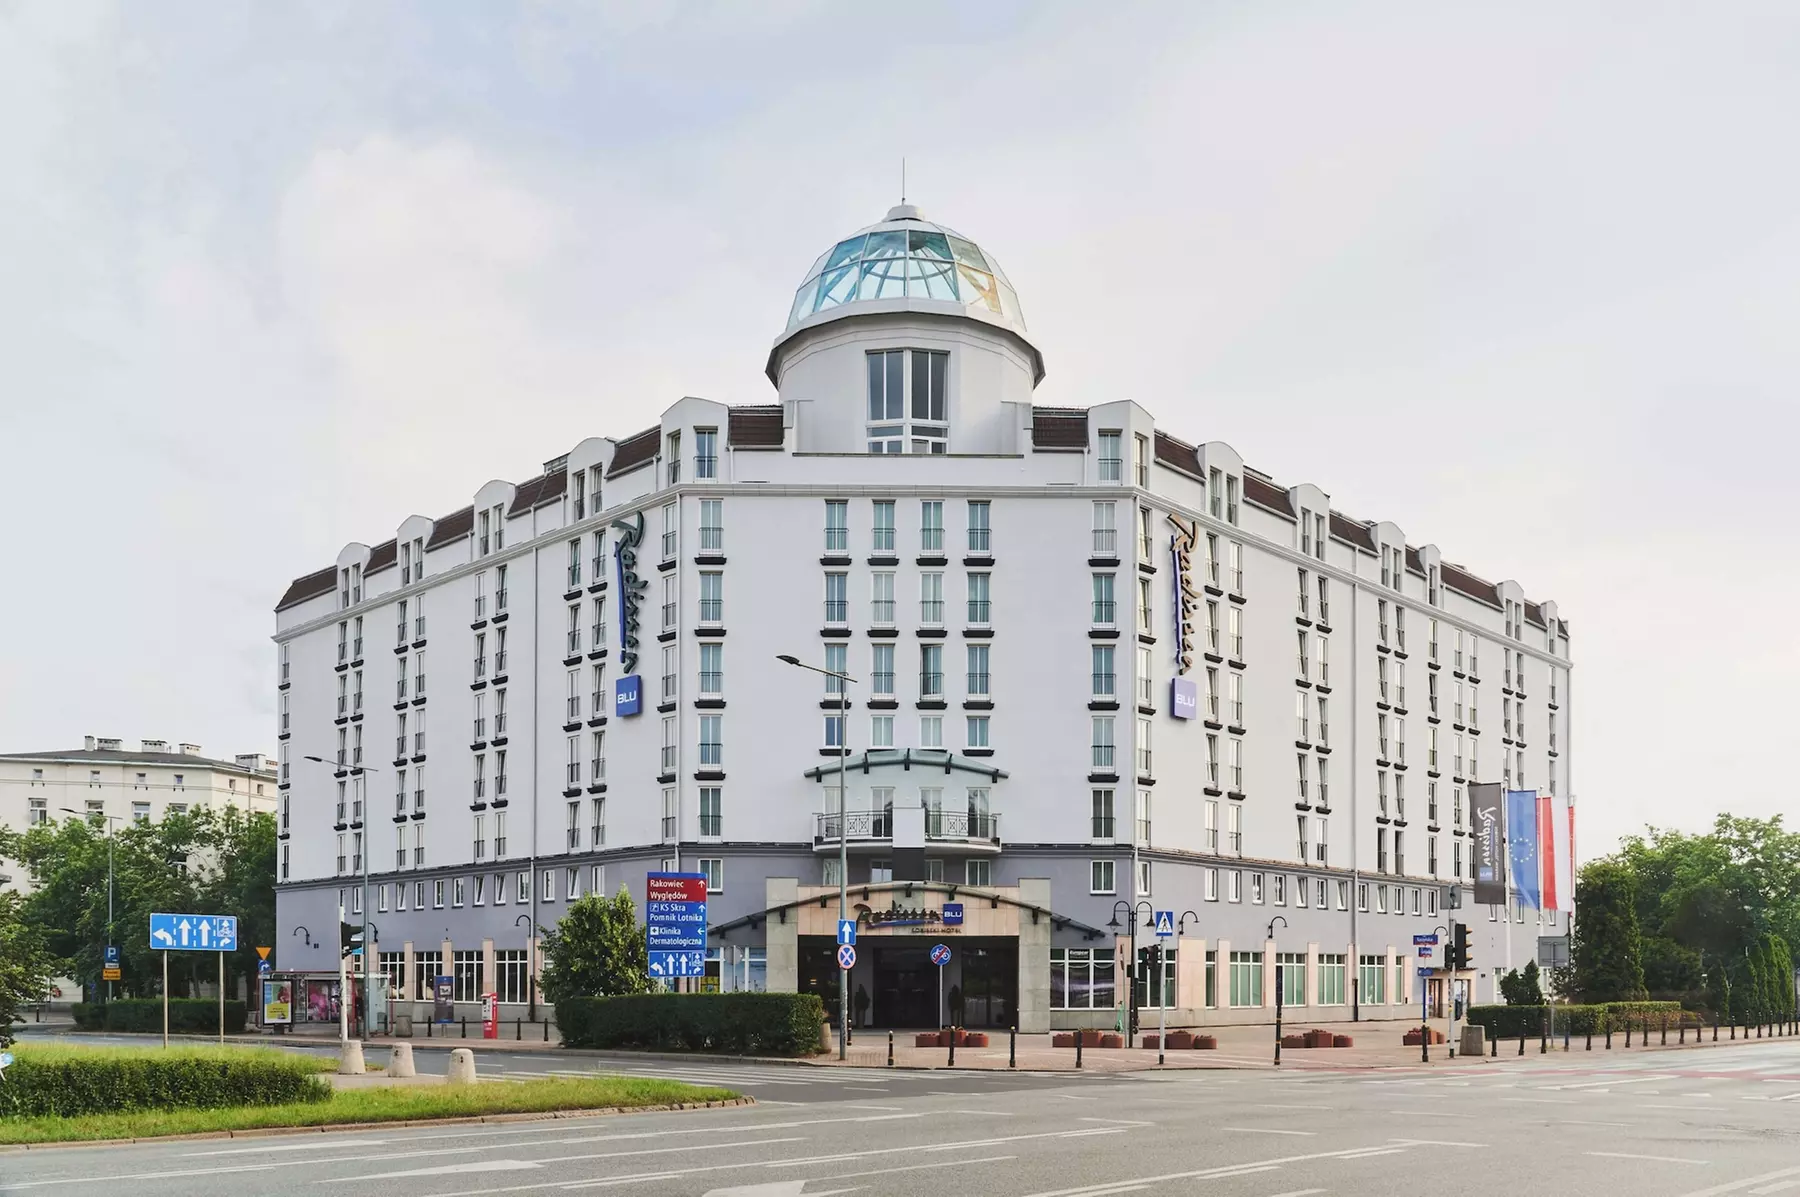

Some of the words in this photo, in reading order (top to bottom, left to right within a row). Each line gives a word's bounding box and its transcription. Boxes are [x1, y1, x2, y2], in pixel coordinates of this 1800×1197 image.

[611, 510, 649, 674] Radisson
[1167, 512, 1203, 676] Radisson
[617, 691, 638, 704] BLU
[1175, 692, 1195, 707] BLU
[650, 879, 684, 888] Rakowiec
[650, 891, 688, 901] Wyględów
[660, 904, 669, 912] KS
[670, 904, 686, 912] Skra
[650, 914, 676, 922] Pomnik
[678, 914, 703, 922] Lotnika
[660, 927, 681, 935] Klinika
[650, 937, 702, 946] Dermatologiczna
